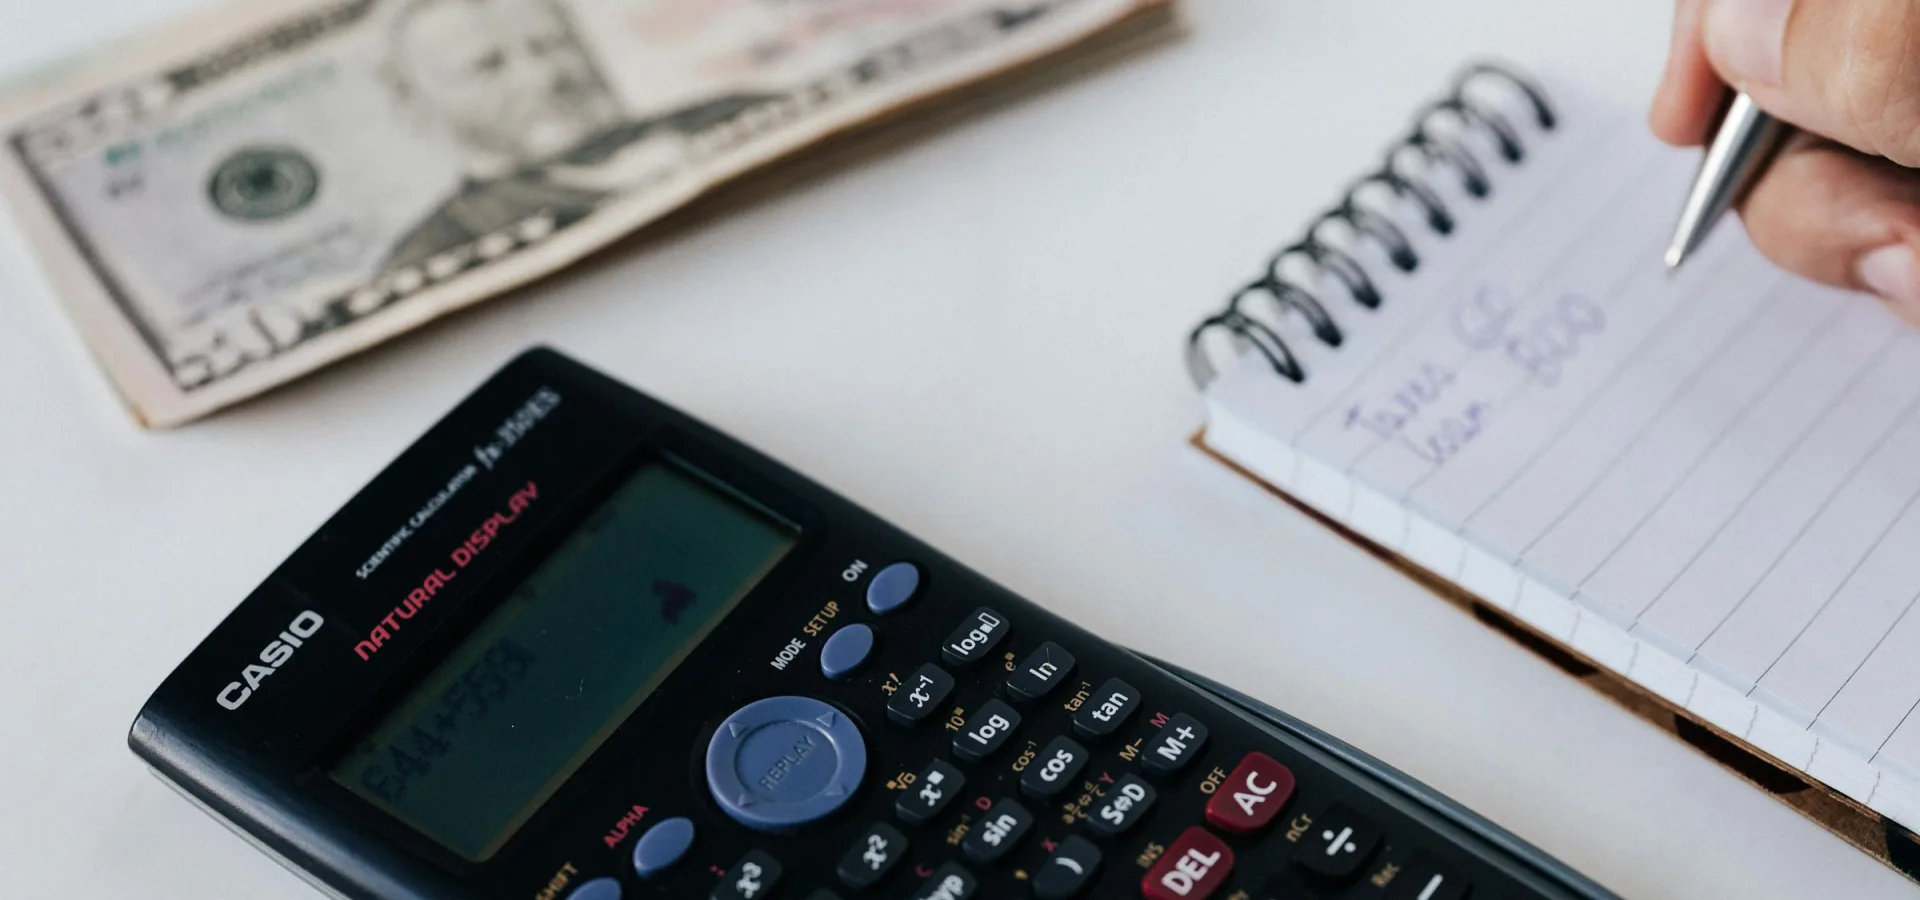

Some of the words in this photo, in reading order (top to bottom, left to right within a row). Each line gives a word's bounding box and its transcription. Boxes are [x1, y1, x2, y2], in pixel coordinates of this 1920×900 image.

[353, 565, 457, 662] NATURAL
[451, 481, 540, 568] DISPLAY
[841, 558, 868, 583] ON
[216, 609, 325, 712] CASIO
[769, 637, 807, 671] MODE
[1092, 691, 1129, 722] tan
[1150, 711, 1170, 729] M
[968, 712, 1010, 745] log
[1157, 725, 1196, 762] M+
[758, 735, 817, 792] REPLAY
[1039, 748, 1074, 783] cos
[1199, 766, 1227, 795] OFF
[1232, 770, 1278, 817] AC
[603, 803, 649, 849] ALPHA
[982, 814, 1018, 846] sin
[1285, 812, 1313, 843] nCr
[1161, 847, 1222, 897] DEL
